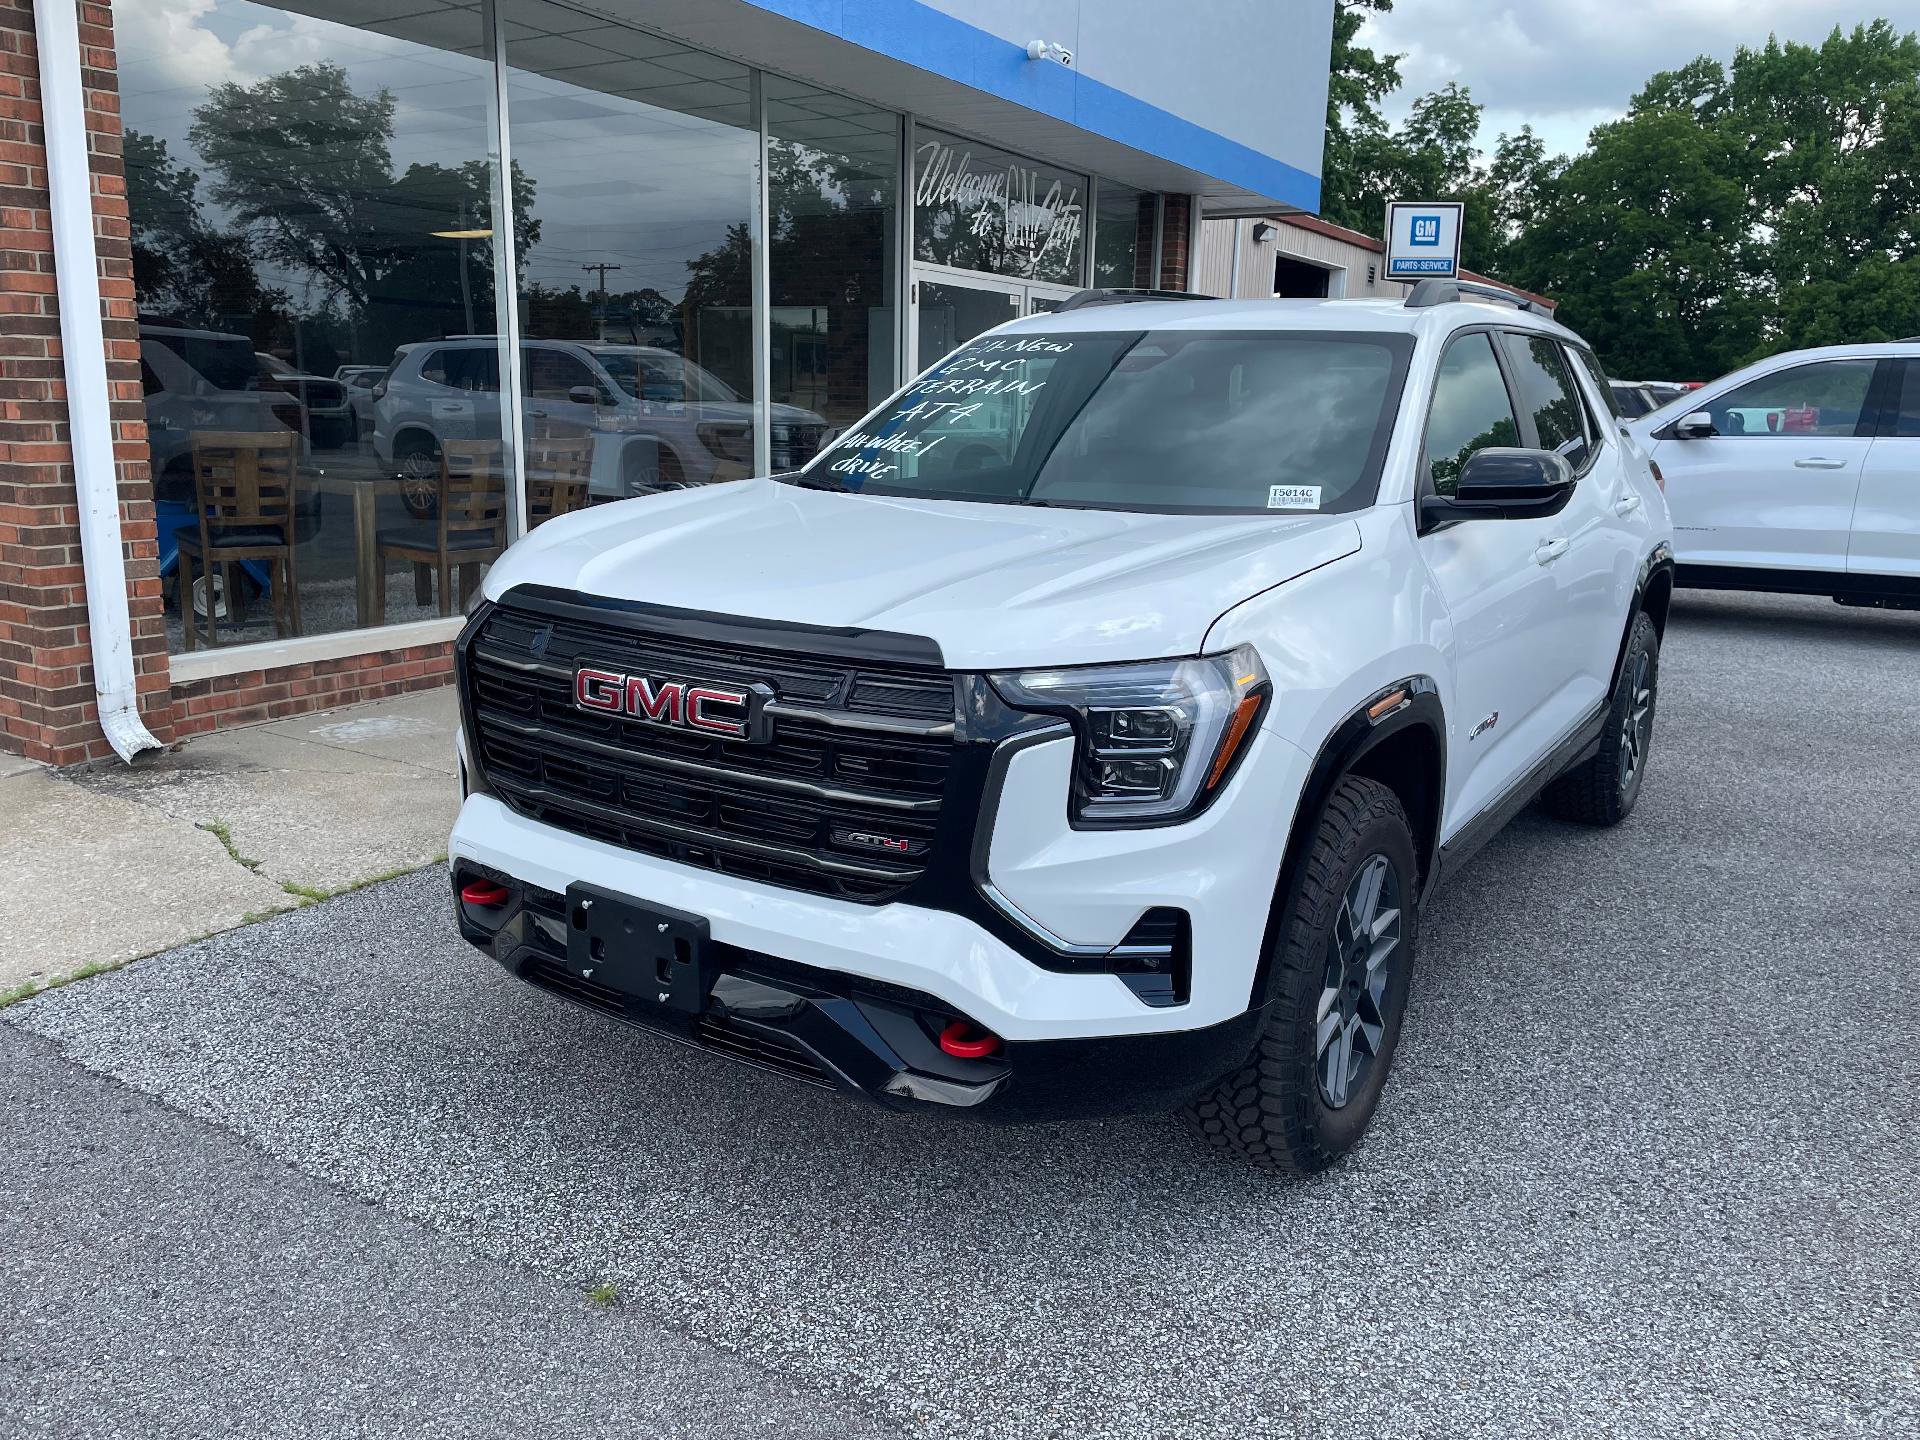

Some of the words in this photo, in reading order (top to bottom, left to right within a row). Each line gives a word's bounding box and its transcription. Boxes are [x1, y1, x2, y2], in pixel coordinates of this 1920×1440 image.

[916, 141, 1005, 206] Welcome
[970, 201, 994, 237] to
[1415, 220, 1437, 237] GM
[1396, 260, 1449, 270] PARTS-SERVICE
[939, 357, 1027, 375] GMC
[905, 378, 1047, 397] TERRAIN
[890, 400, 983, 424] AT4
[577, 668, 748, 737] GMC
[847, 832, 909, 851] AT4
